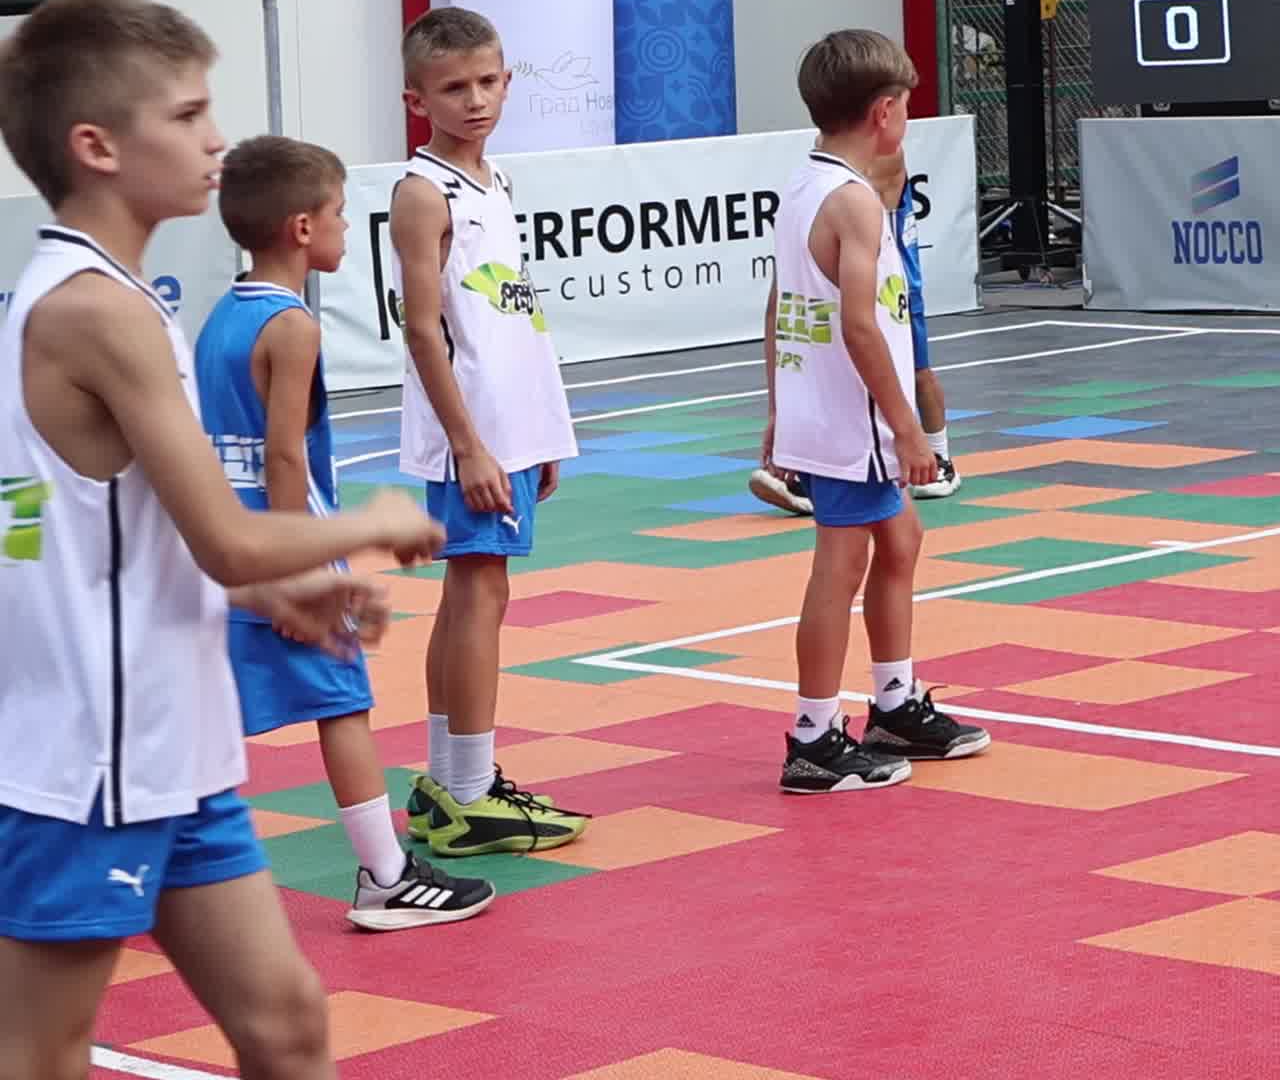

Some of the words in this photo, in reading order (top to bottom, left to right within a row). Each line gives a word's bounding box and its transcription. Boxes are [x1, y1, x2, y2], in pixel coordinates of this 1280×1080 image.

[1166, 5, 1199, 50] 0
[1172, 221, 1264, 265] NOCCO
[560, 261, 722, 302] custom
